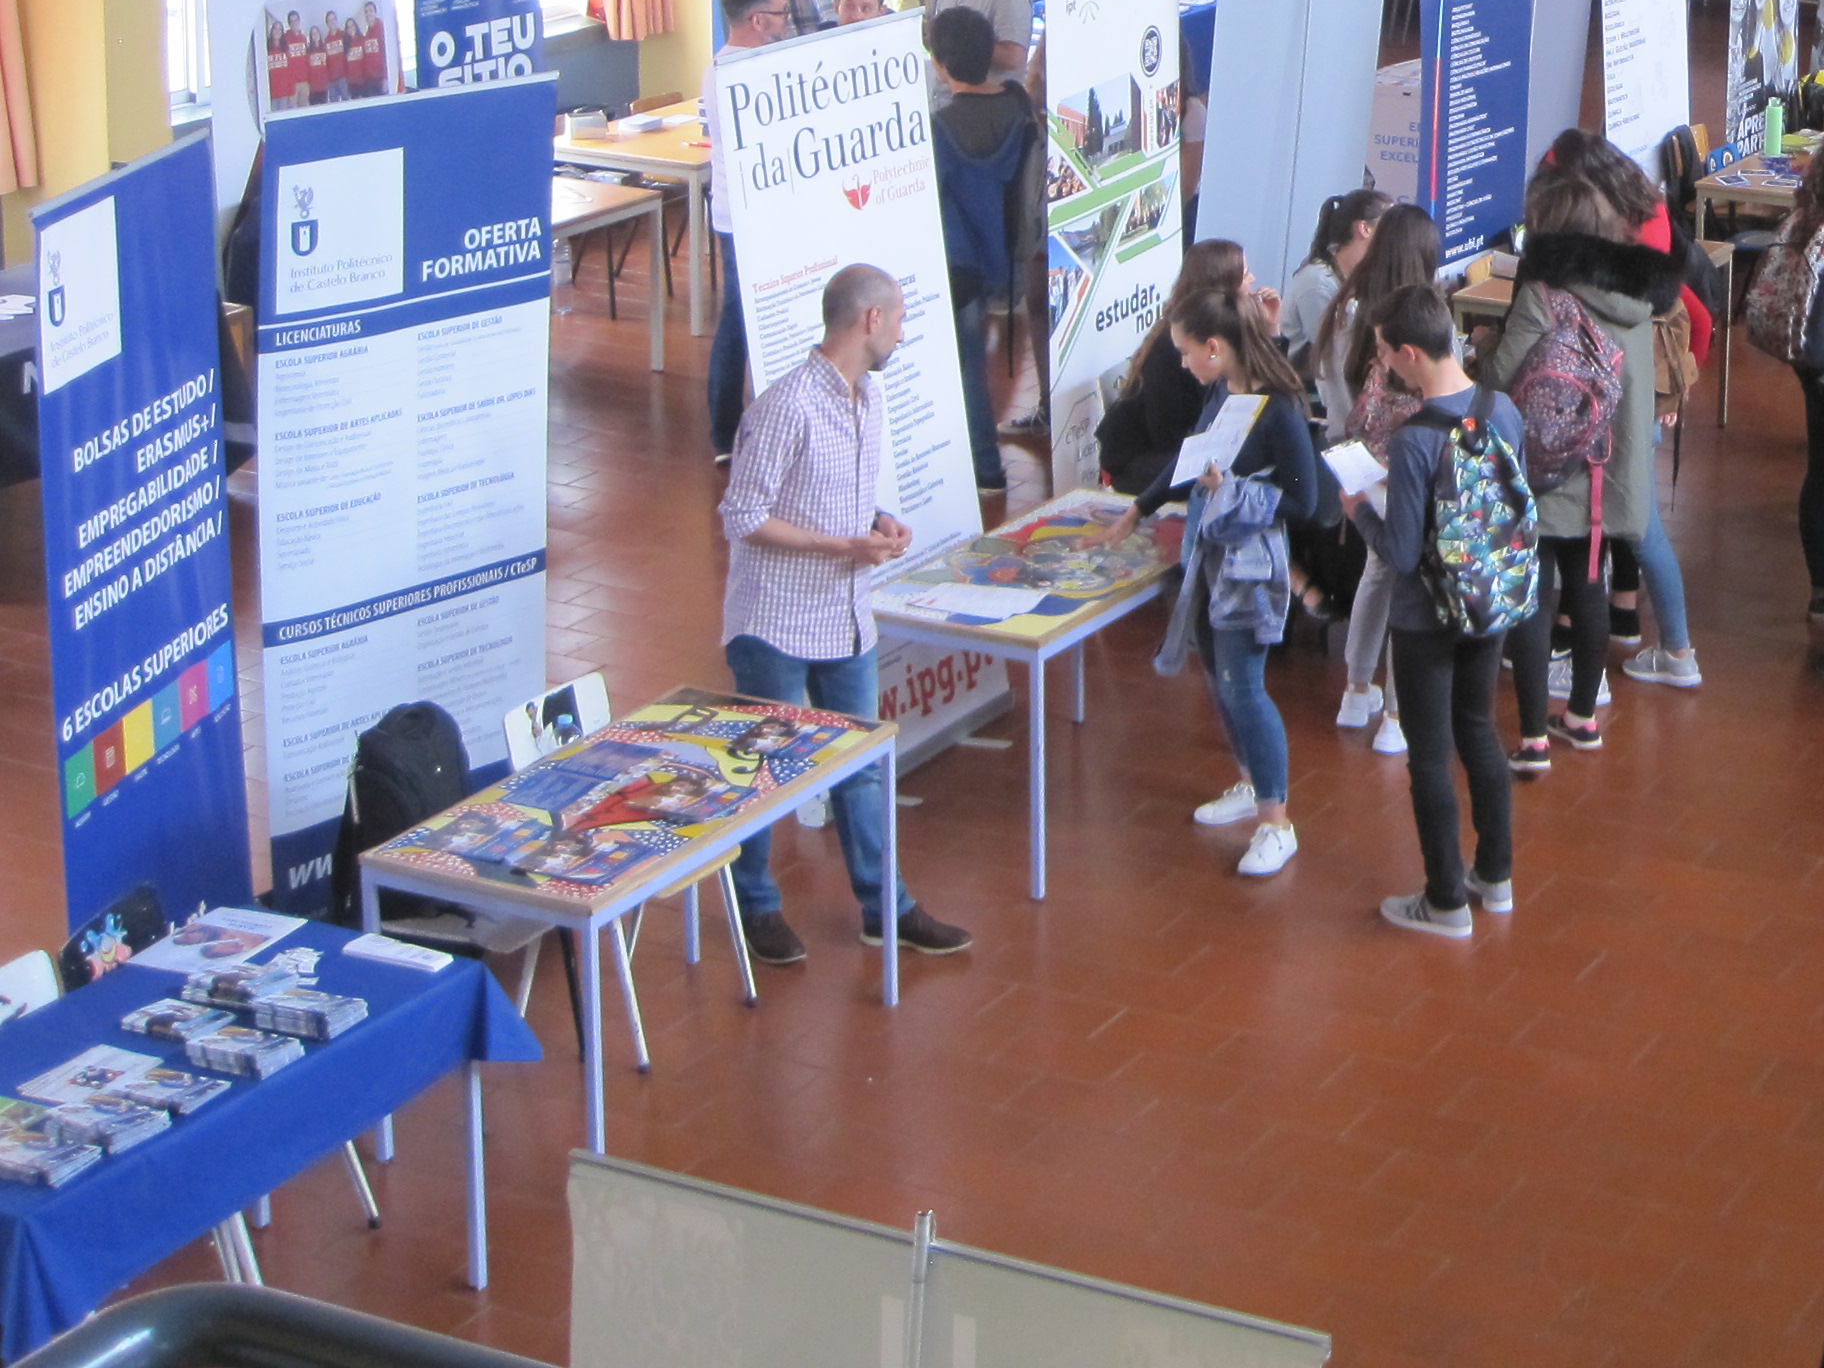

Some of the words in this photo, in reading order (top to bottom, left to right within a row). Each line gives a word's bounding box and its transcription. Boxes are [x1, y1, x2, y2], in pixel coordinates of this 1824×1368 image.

[430, 31, 455, 68] O
[465, 12, 536, 60] TEU
[726, 49, 918, 152] Politécnico
[752, 142, 787, 191] da
[793, 102, 927, 179] Guarda
[873, 155, 930, 185] Polytechnic
[875, 189, 886, 205] of
[887, 178, 926, 202] Guarda
[422, 239, 542, 283] FORMATIVA
[464, 216, 542, 250] OFERTA
[290, 262, 335, 279] Instituto
[337, 253, 393, 271] Politécnico
[290, 280, 304, 294] de
[306, 273, 347, 292] Castelo
[349, 267, 386, 283] Branco
[275, 319, 362, 347] LICENCIATURAS
[1095, 283, 1156, 332] estudar
[73, 419, 130, 473] BOLSAS
[132, 407, 153, 438] DE
[153, 374, 207, 425] ESTUDO
[137, 413, 209, 473] ERASMUS+
[78, 446, 209, 550] EMPREGABILIDADE
[64, 480, 213, 599] EMPREENDEDORISMO
[75, 574, 129, 631] ENSINO
[132, 566, 143, 592] A
[144, 517, 216, 583] DISTÂNCIA
[279, 618, 323, 640] CURSOS
[324, 605, 371, 630] TÉCNICOS
[372, 587, 432, 617] SUPERIORES
[433, 567, 503, 598] PROFISSIONAIS
[62, 716, 73, 743] 6
[75, 665, 142, 734] ESCOLAS
[144, 602, 229, 683] SUPERIORES
